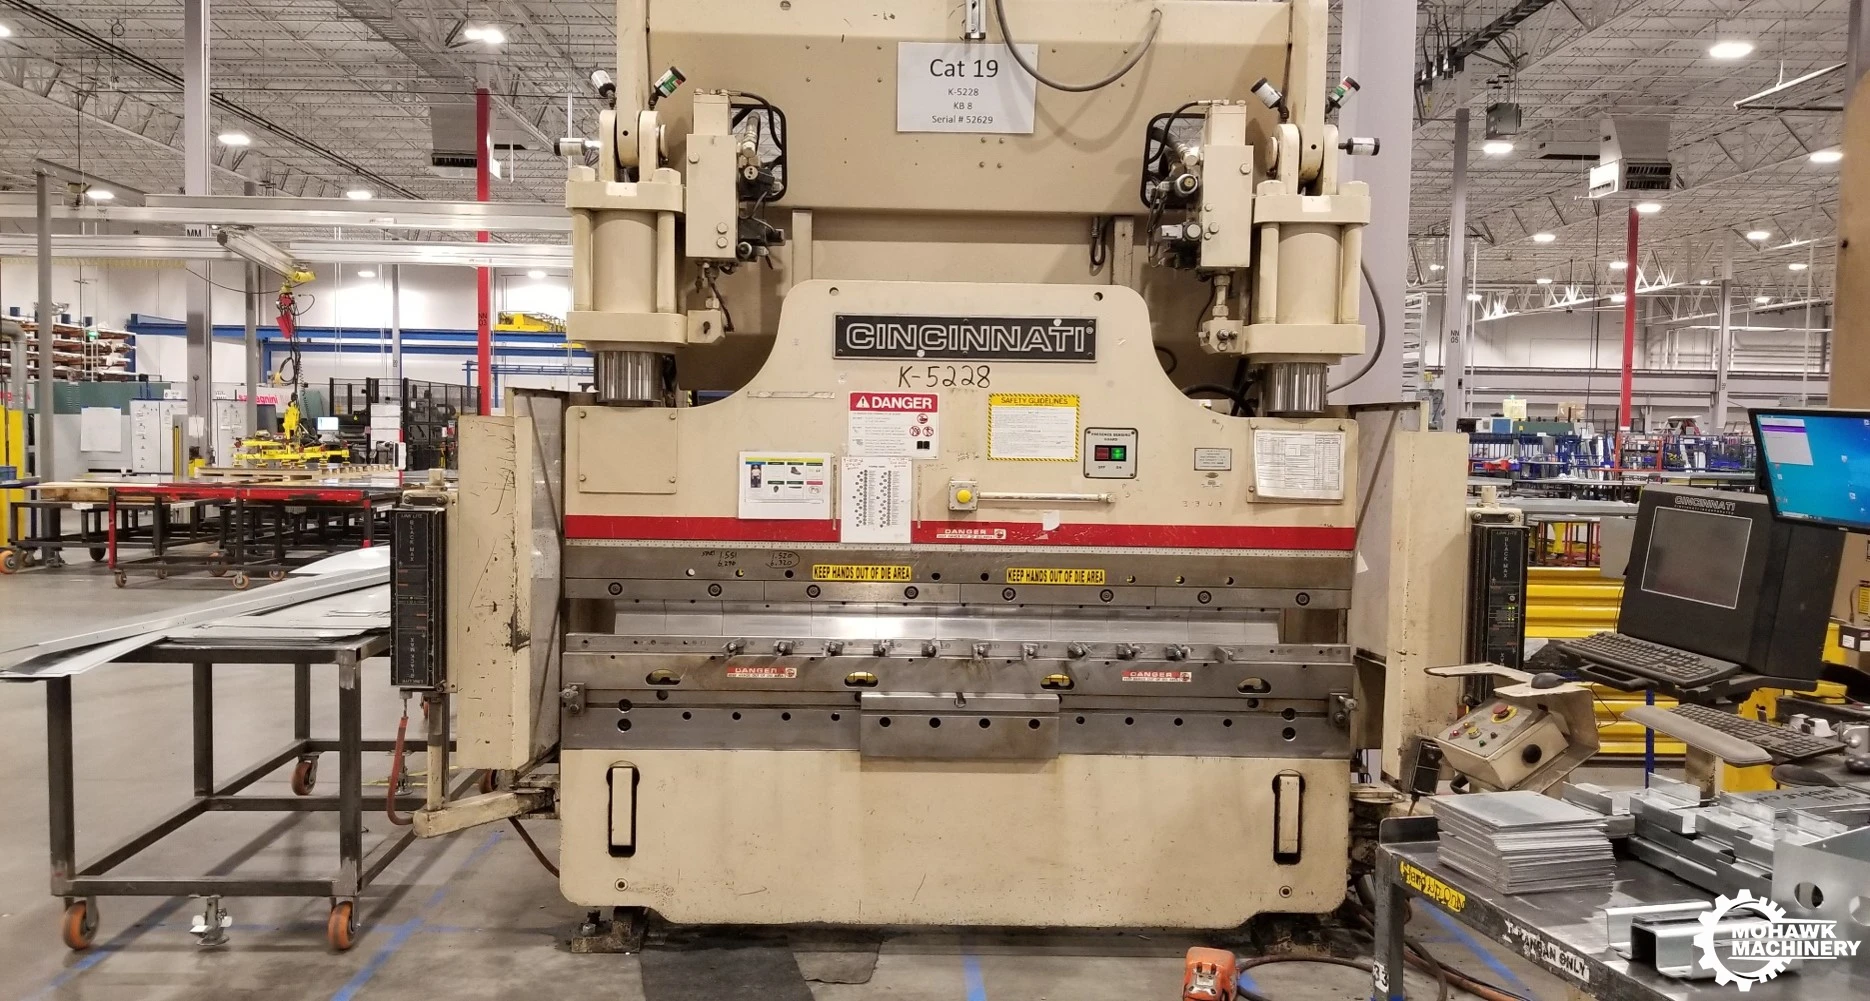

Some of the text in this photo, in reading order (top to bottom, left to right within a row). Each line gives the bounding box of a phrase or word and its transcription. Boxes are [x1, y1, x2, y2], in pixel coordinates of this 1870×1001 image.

[930, 58, 999, 78] Cat 19
[947, 88, 980, 96] K-5228
[953, 102, 973, 110] KB 8
[931, 115, 994, 124] Serial # 52629
[846, 322, 1086, 353] CINCINNATI
[1450, 329, 1460, 337] NN
[898, 365, 991, 389] K-5228
[871, 396, 933, 410] DANGER
[1028, 397, 1069, 405] GUIDELINES
[813, 566, 910, 580] KEEP HANDS OUT OF DIE AREA
[1007, 569, 1104, 583] KEEP HANDS OUT OF DIE AREA
